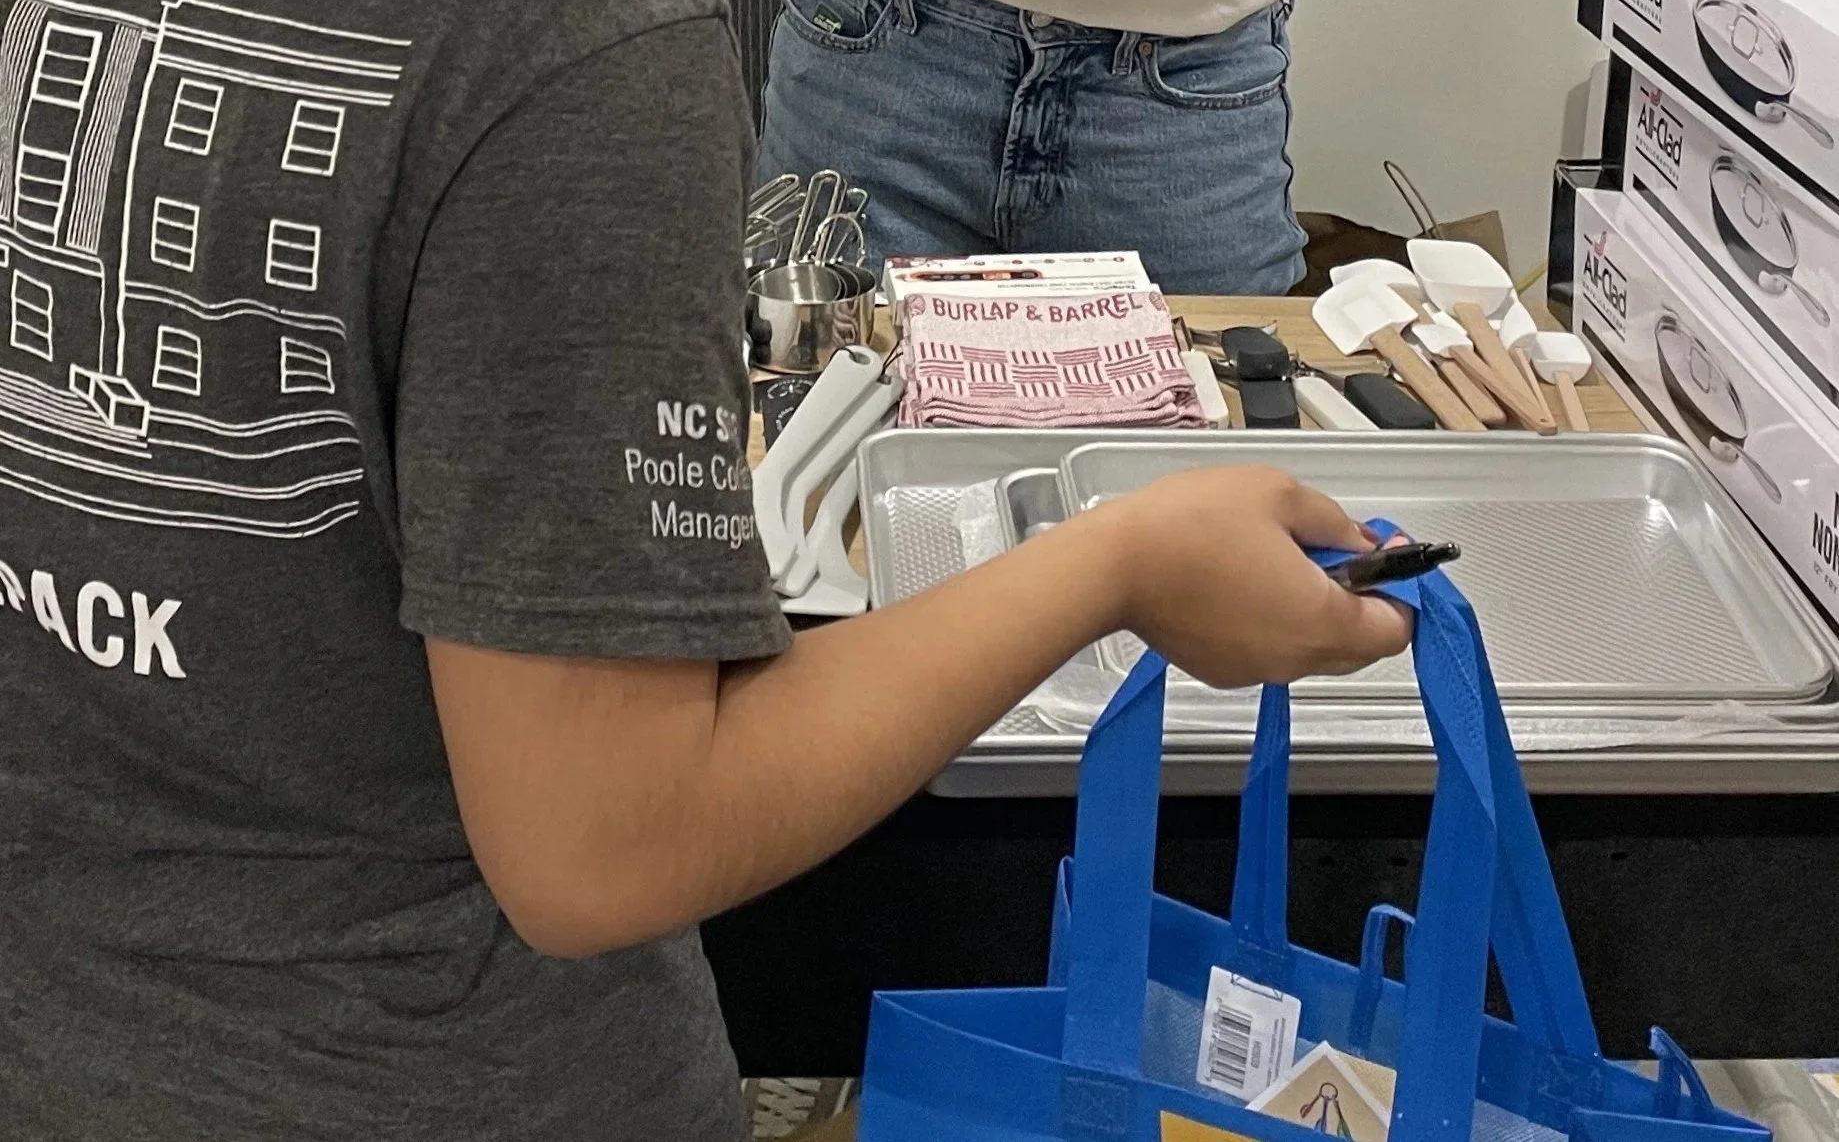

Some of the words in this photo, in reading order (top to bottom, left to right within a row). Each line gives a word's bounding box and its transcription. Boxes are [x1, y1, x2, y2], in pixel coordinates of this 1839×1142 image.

[1637, 103, 1683, 168] All-Clad
[1583, 249, 1627, 320] All-Clad
[932, 296, 1019, 322] BURLAP
[1025, 305, 1045, 322] &
[1049, 292, 1144, 323] BARREL
[656, 400, 708, 440] NC
[624, 447, 704, 489] Poole
